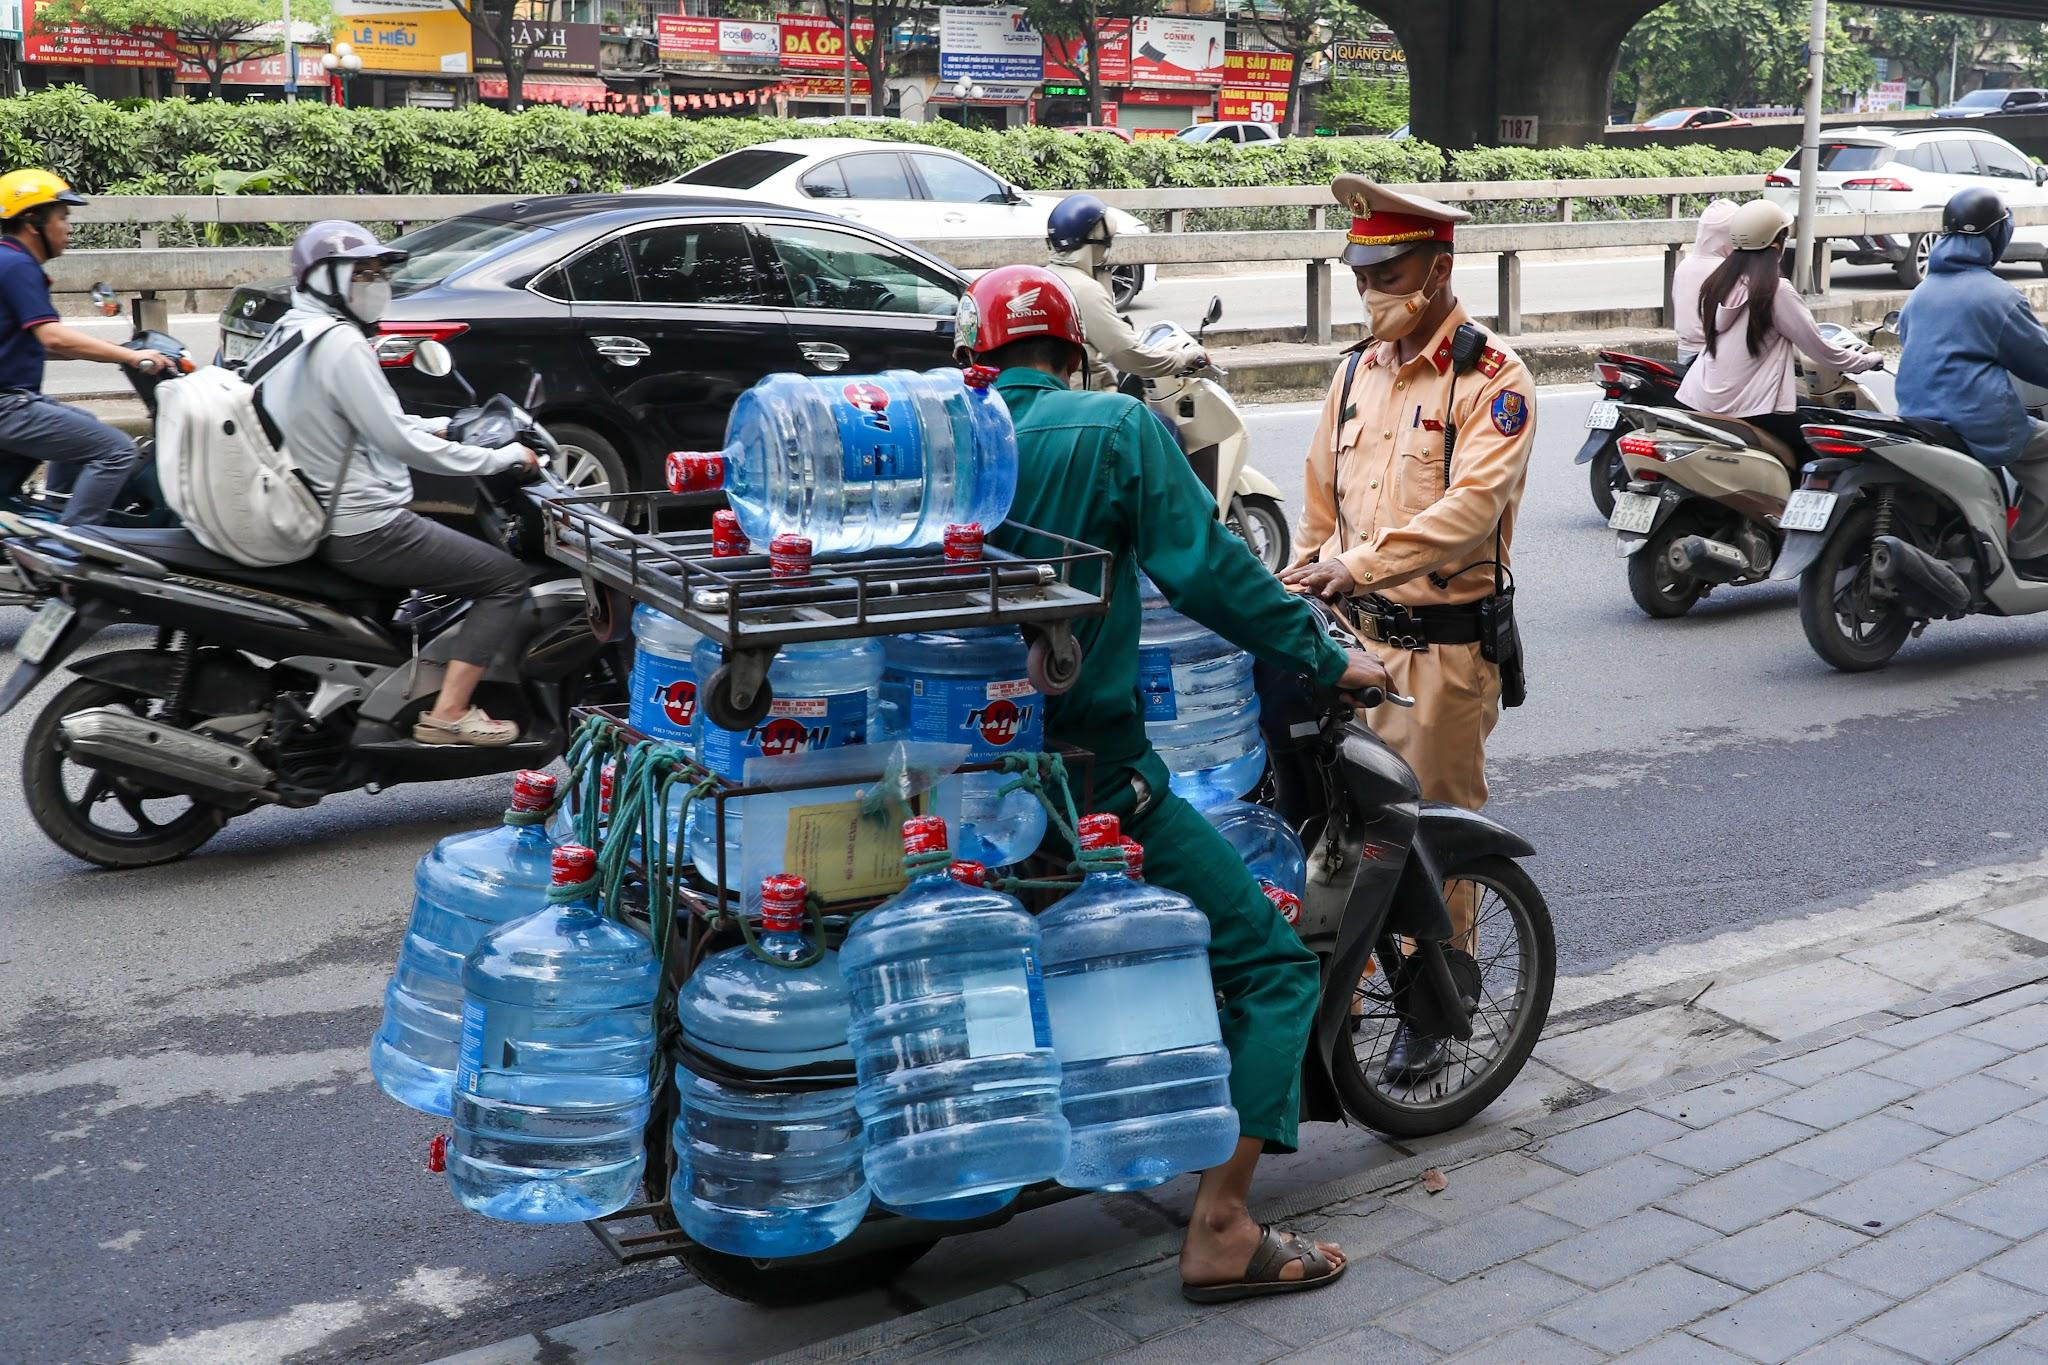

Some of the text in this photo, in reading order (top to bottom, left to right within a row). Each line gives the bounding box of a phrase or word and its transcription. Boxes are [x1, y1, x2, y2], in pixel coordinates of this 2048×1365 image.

[353, 27, 416, 46] LÊ HIẾU
[785, 31, 812, 53] ĐÁ
[815, 30, 842, 54] ỐP
[1163, 32, 1196, 41] CONMIK
[534, 49, 567, 58] MART
[1225, 54, 1292, 71] VUA SẦU RIÊN
[261, 61, 281, 75] XE
[298, 59, 325, 78] IỆN
[1221, 89, 1246, 99] THÁNG
[1250, 102, 1275, 121] 59
[1006, 309, 1048, 320] HONDA
[1783, 510, 1826, 528] 891.05
[964, 704, 1034, 736] Miru
[745, 725, 831, 755] Miru
